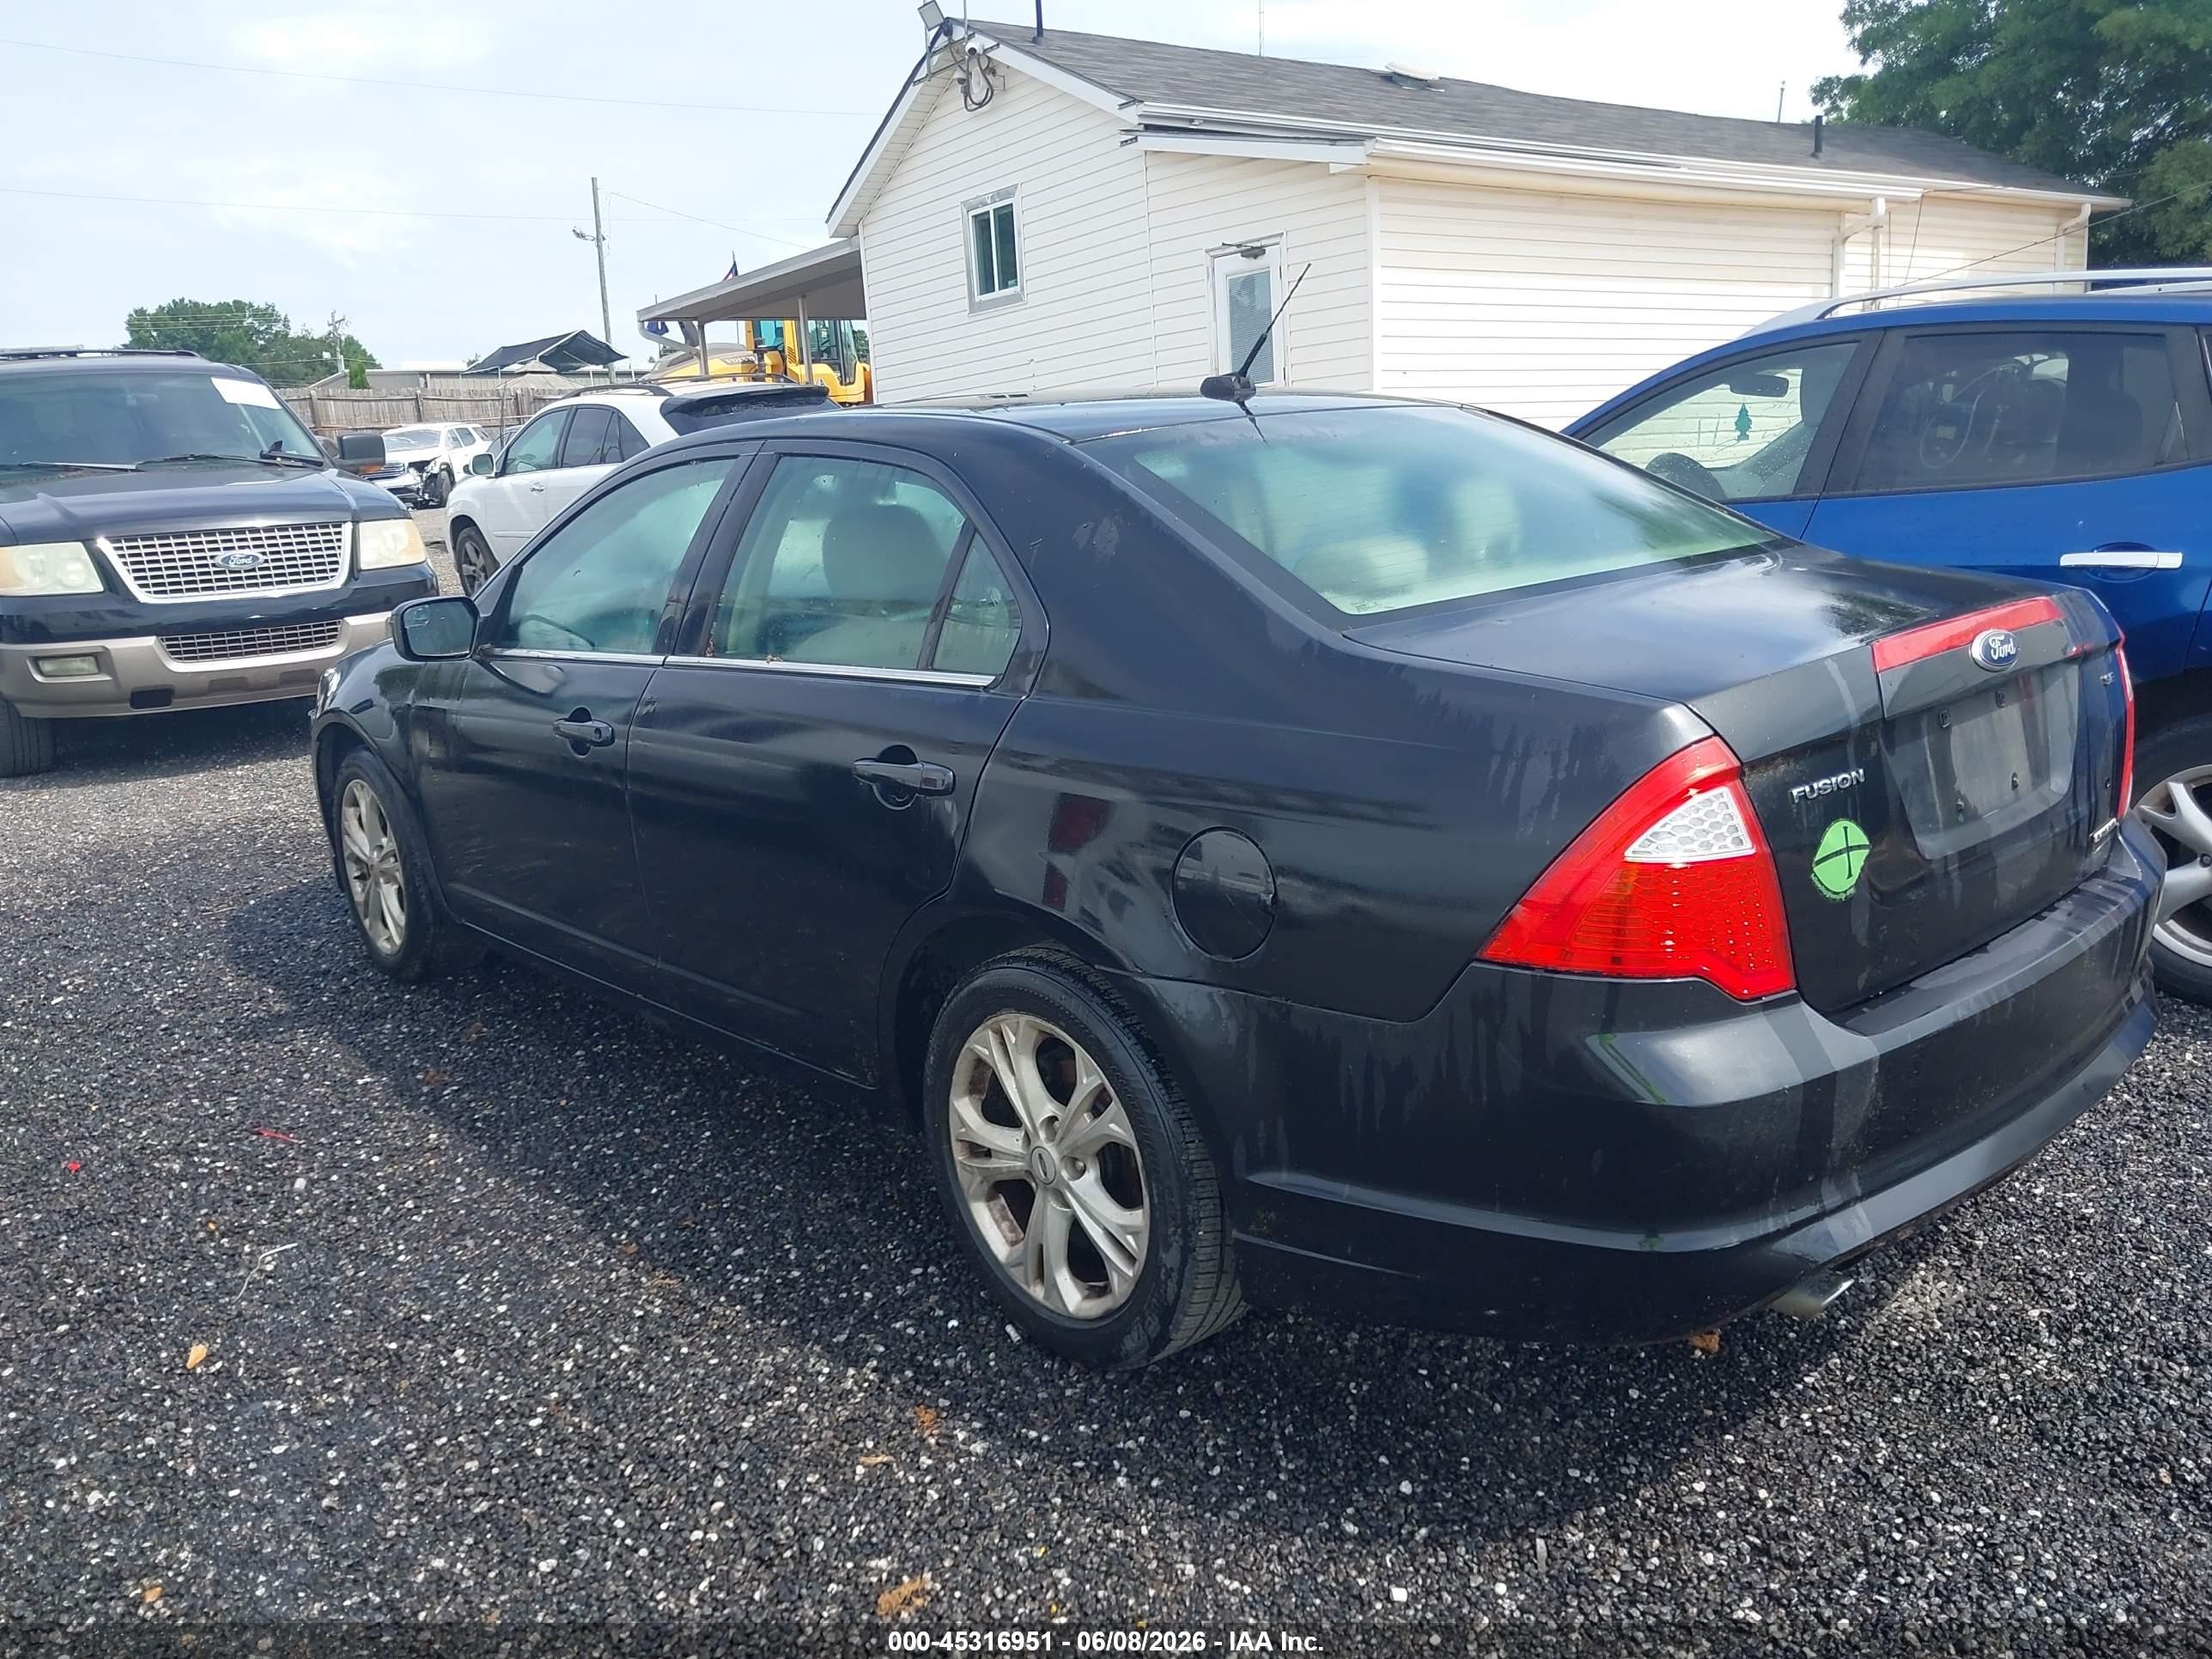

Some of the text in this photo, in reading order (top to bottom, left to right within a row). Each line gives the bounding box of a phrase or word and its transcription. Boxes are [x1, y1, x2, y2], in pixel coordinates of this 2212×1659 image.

[228, 554, 253, 565] Ford
[1989, 635, 2016, 660] Ford
[1790, 769, 1865, 804] FUSION
